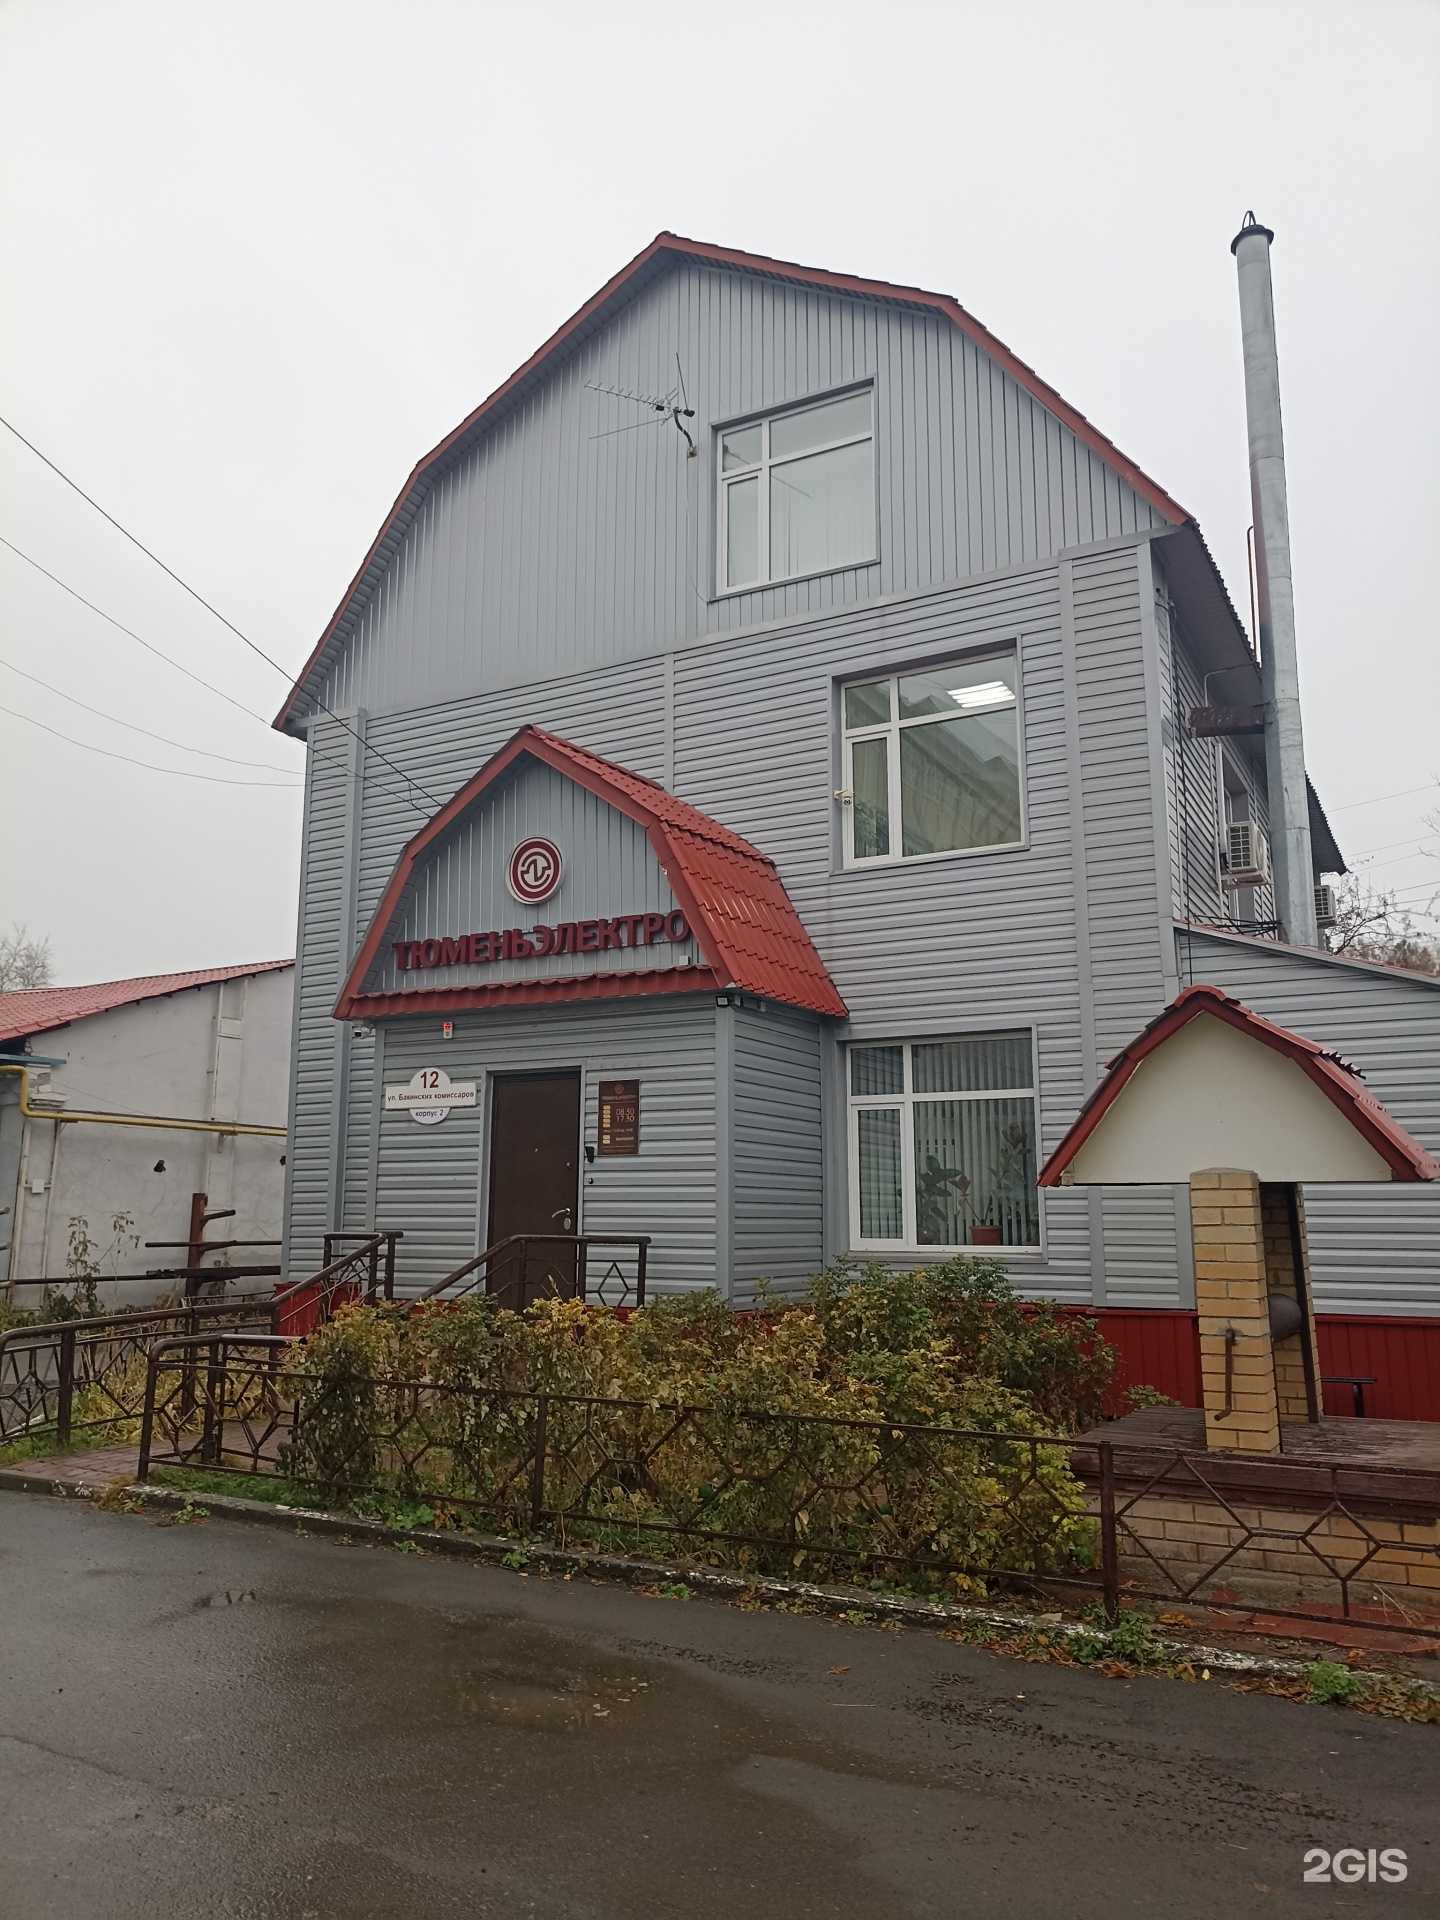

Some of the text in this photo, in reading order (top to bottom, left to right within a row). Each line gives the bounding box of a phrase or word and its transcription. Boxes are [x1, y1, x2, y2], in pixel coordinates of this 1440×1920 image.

[392, 908, 690, 971] ТЮМЕНЬЭЛЕКТРО
[420, 1070, 439, 1089] 12
[398, 1093, 432, 1101] Бакинских
[434, 1091, 474, 1099] комиссаров
[415, 1109, 438, 1118] корпус
